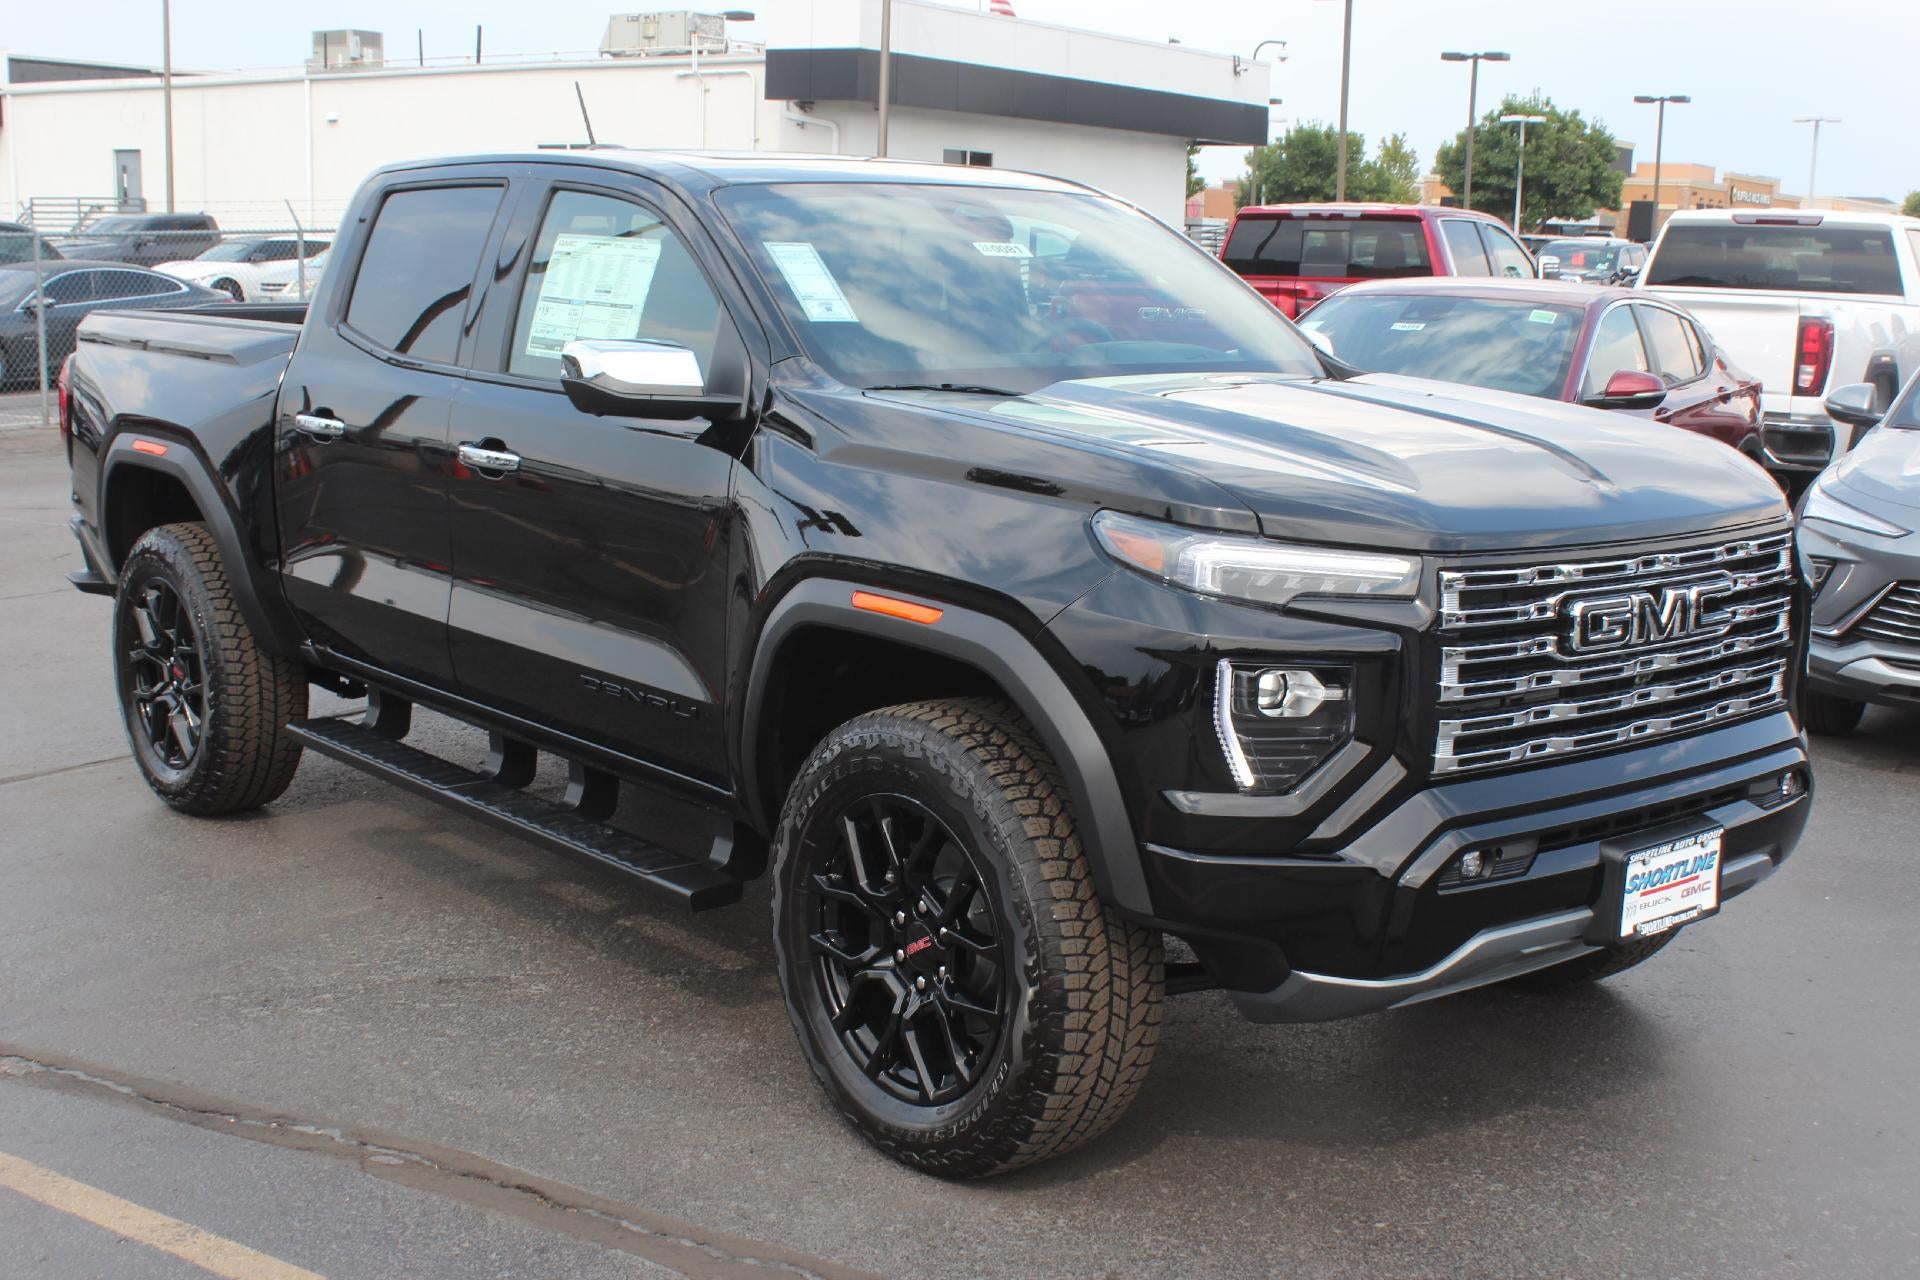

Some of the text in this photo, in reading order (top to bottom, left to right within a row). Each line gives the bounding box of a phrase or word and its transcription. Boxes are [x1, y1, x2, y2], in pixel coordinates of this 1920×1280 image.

[1573, 581, 1735, 650] GMC
[580, 674, 697, 719] DENALI
[1624, 850, 1718, 894] SHORTLINE
[1629, 844, 1674, 863] SHORTLINE
[1639, 880, 1712, 911] BUICK GMC
[906, 936, 932, 955] GMC
